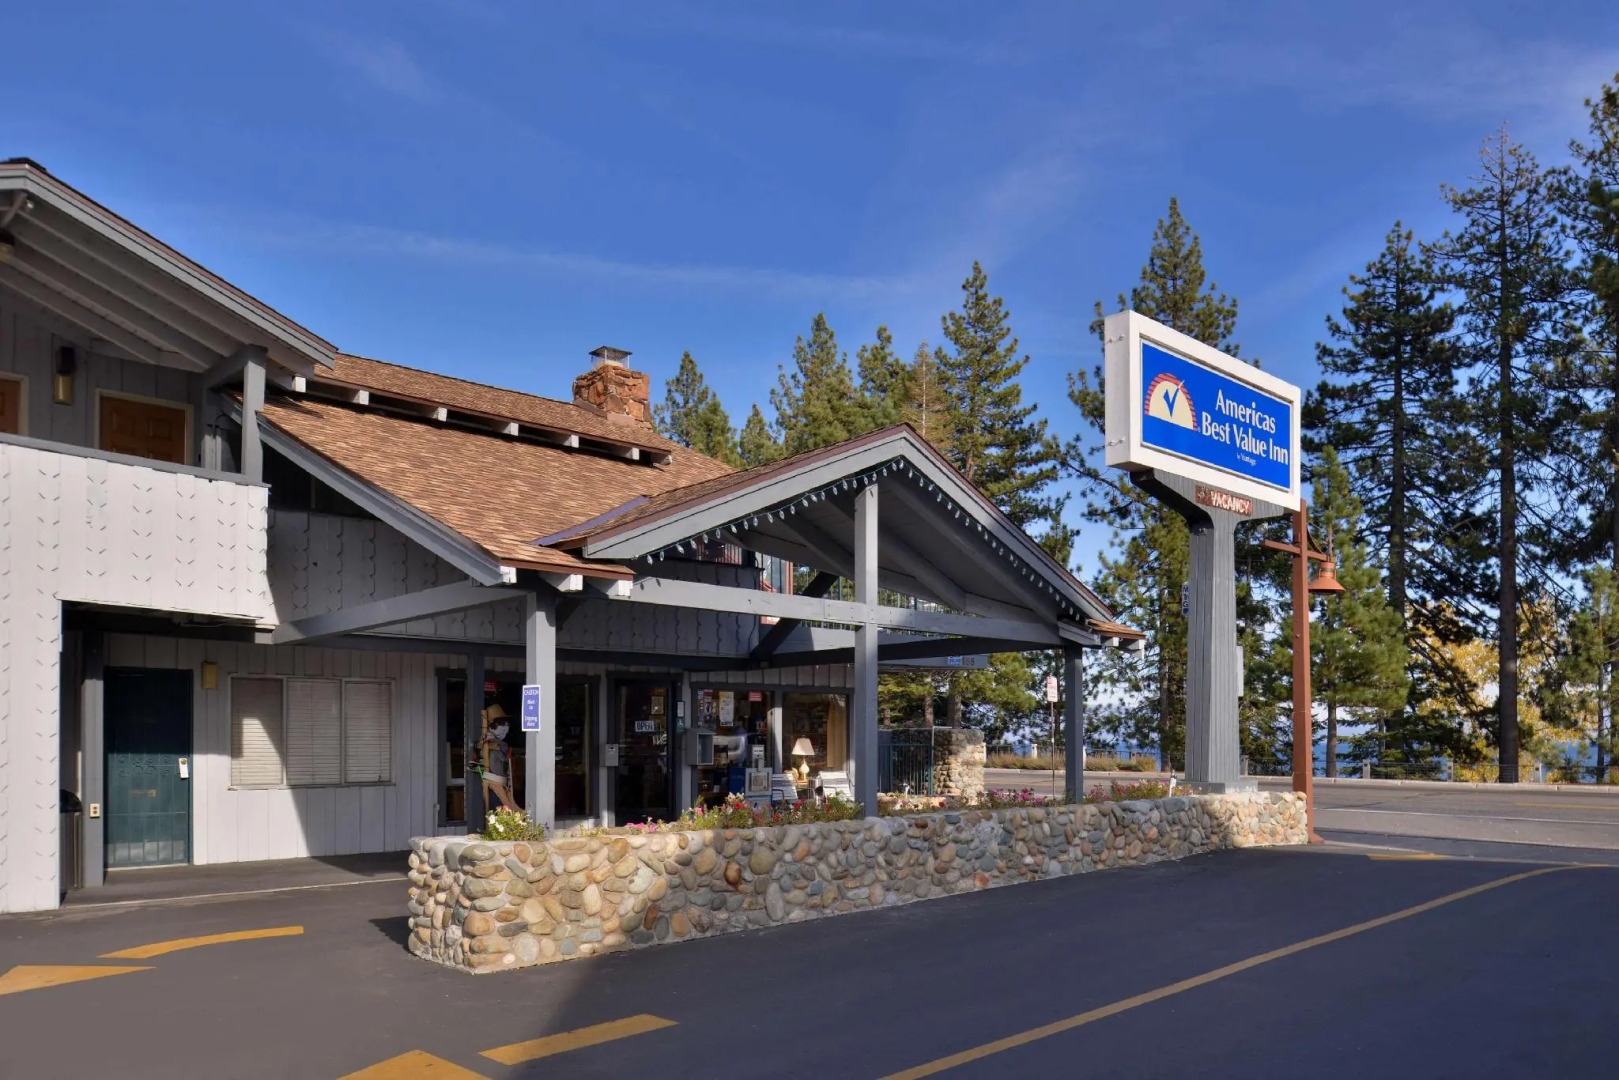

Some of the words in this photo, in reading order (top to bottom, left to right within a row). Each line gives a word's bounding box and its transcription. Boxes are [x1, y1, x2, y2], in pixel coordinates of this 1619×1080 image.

[1215, 389, 1276, 434] Americas
[1202, 412, 1231, 445] Best
[1232, 424, 1267, 457] Value
[1269, 438, 1288, 465] Inn
[1210, 490, 1250, 514] VACANCY
